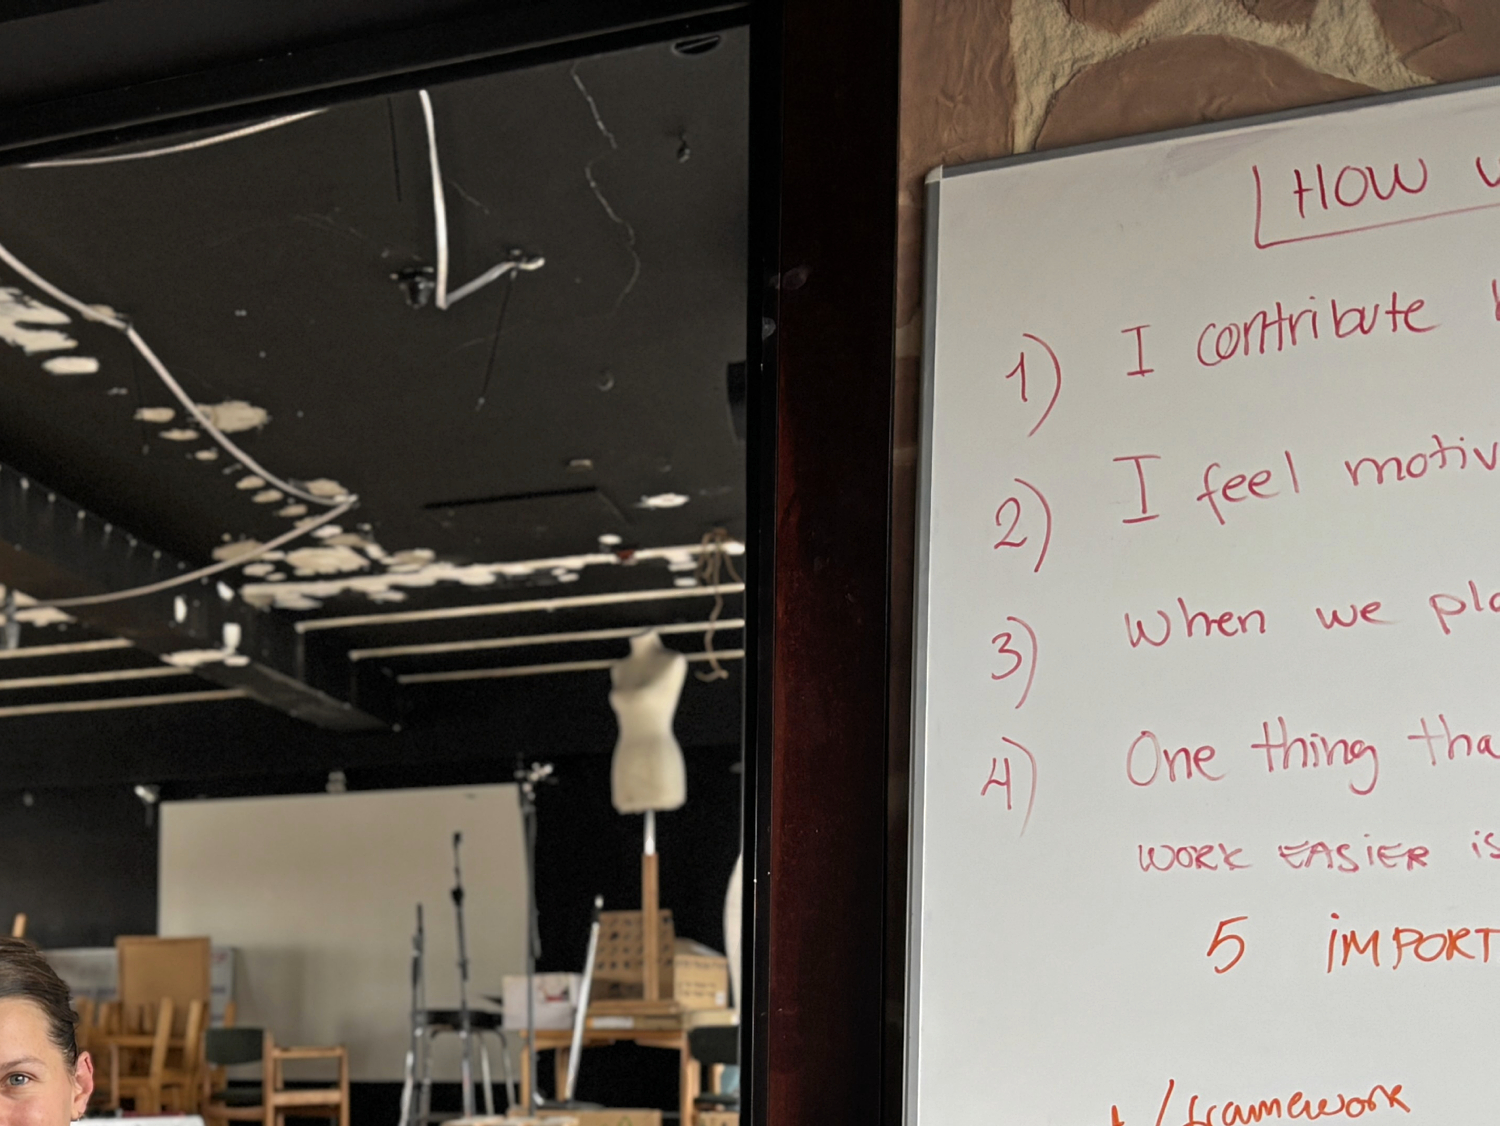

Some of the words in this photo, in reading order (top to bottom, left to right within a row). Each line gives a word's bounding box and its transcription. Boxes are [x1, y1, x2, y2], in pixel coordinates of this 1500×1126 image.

[1293, 157, 1429, 219] HOW
[1005, 332, 1063, 437] 1)
[1121, 324, 1156, 378] I
[1196, 290, 1442, 367] contribute
[993, 477, 1053, 573] 2)
[1113, 453, 1161, 525] I
[1196, 450, 1300, 526] feel
[1344, 433, 1499, 487] motiv
[990, 615, 1039, 710] 3)
[1315, 599, 1396, 629] we
[980, 736, 1038, 838] 4)
[1126, 729, 1226, 787] One
[1250, 715, 1379, 796] thing
[1406, 713, 1500, 767] tha
[1206, 915, 1249, 975] 5
